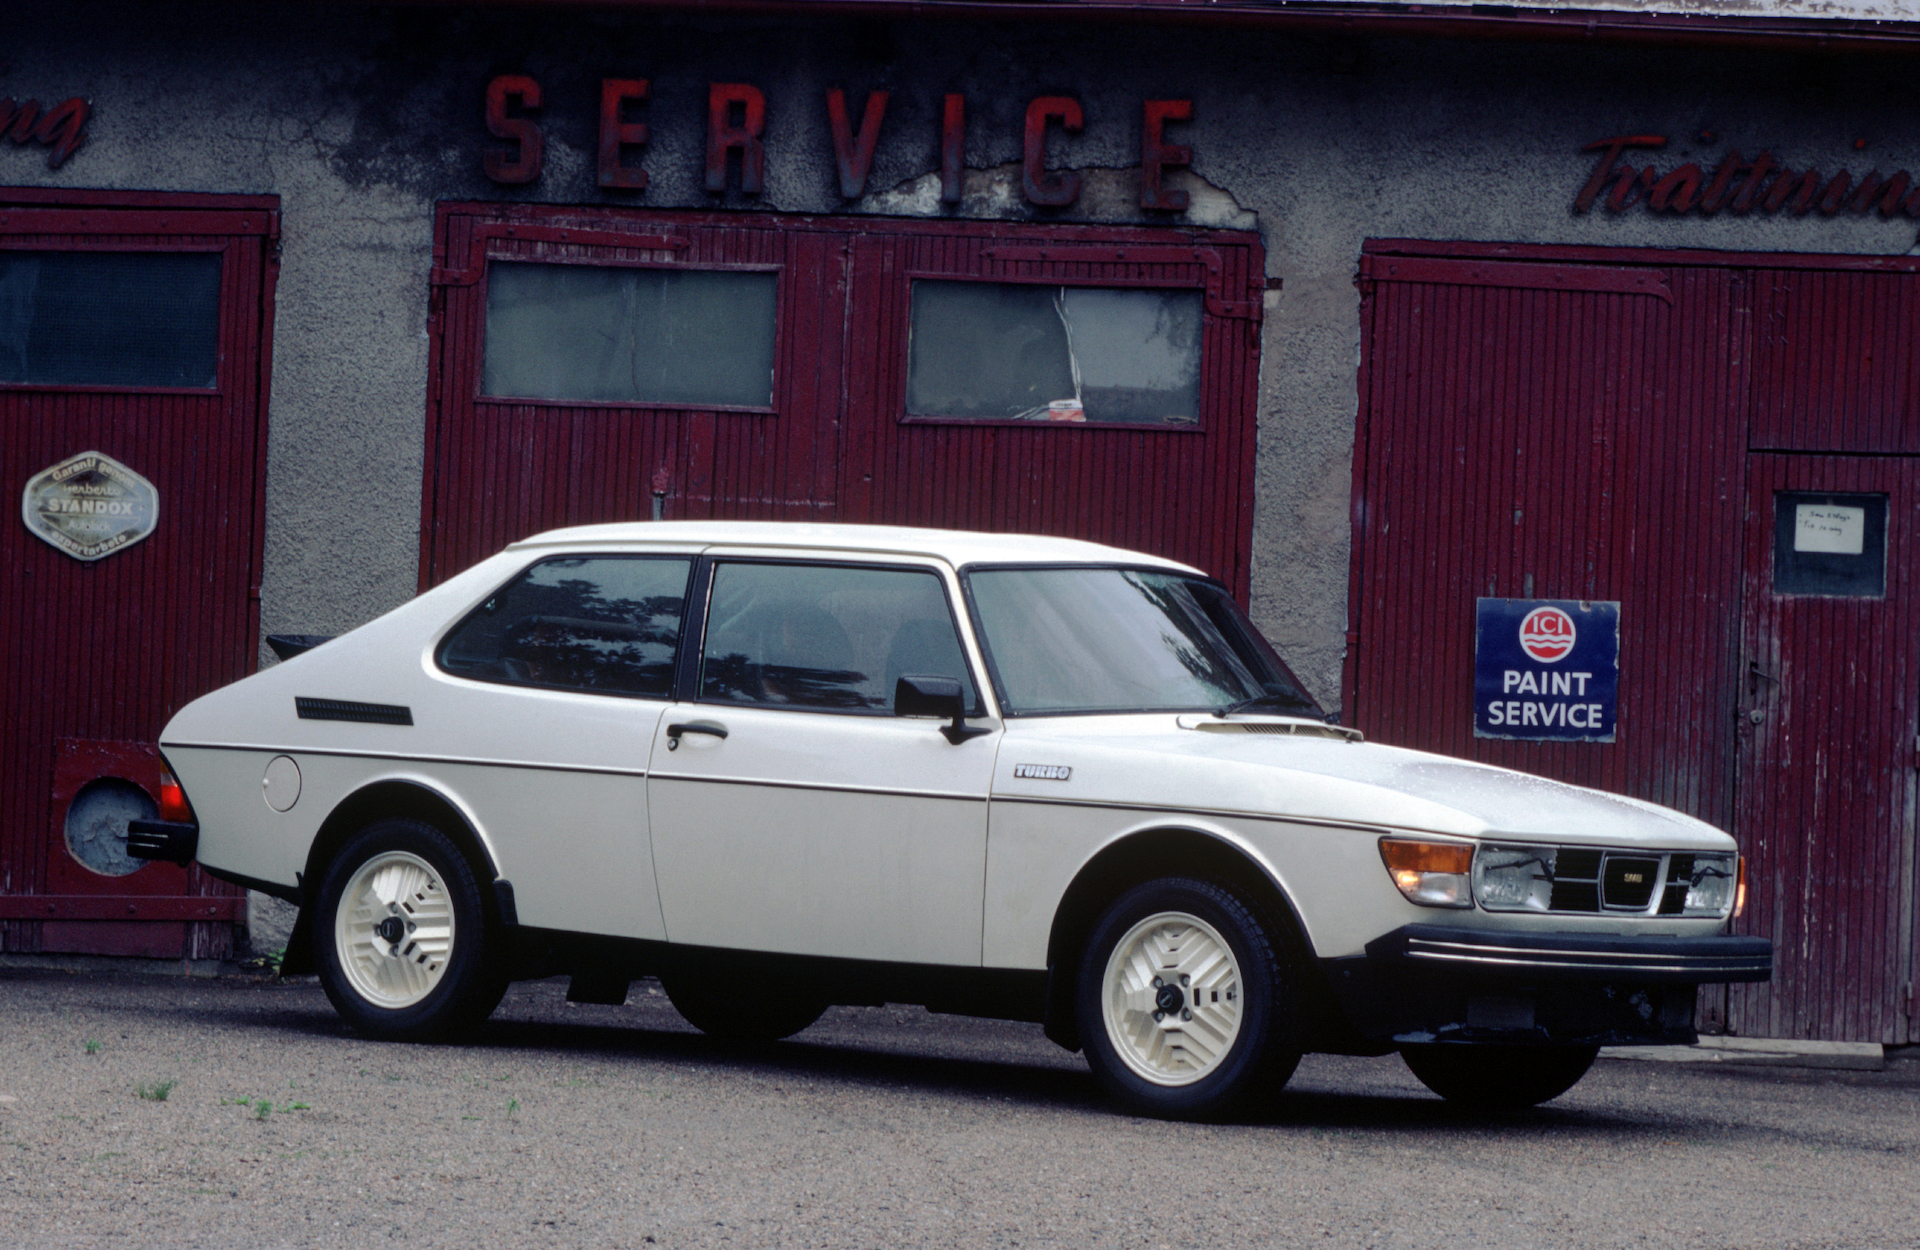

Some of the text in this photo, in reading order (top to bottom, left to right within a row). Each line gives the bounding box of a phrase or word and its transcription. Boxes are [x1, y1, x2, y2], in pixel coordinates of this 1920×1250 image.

[0, 96, 91, 169] ng
[483, 74, 1194, 211] SERVICE
[52, 458, 136, 488] Garanti genom
[48, 498, 133, 515] STANDOX
[51, 531, 127, 556] expertarbete
[1533, 616, 1563, 634] ICI
[1503, 670, 1592, 696] PAINT
[1488, 701, 1602, 728] SERVICE
[1015, 764, 1070, 780] TURBO
